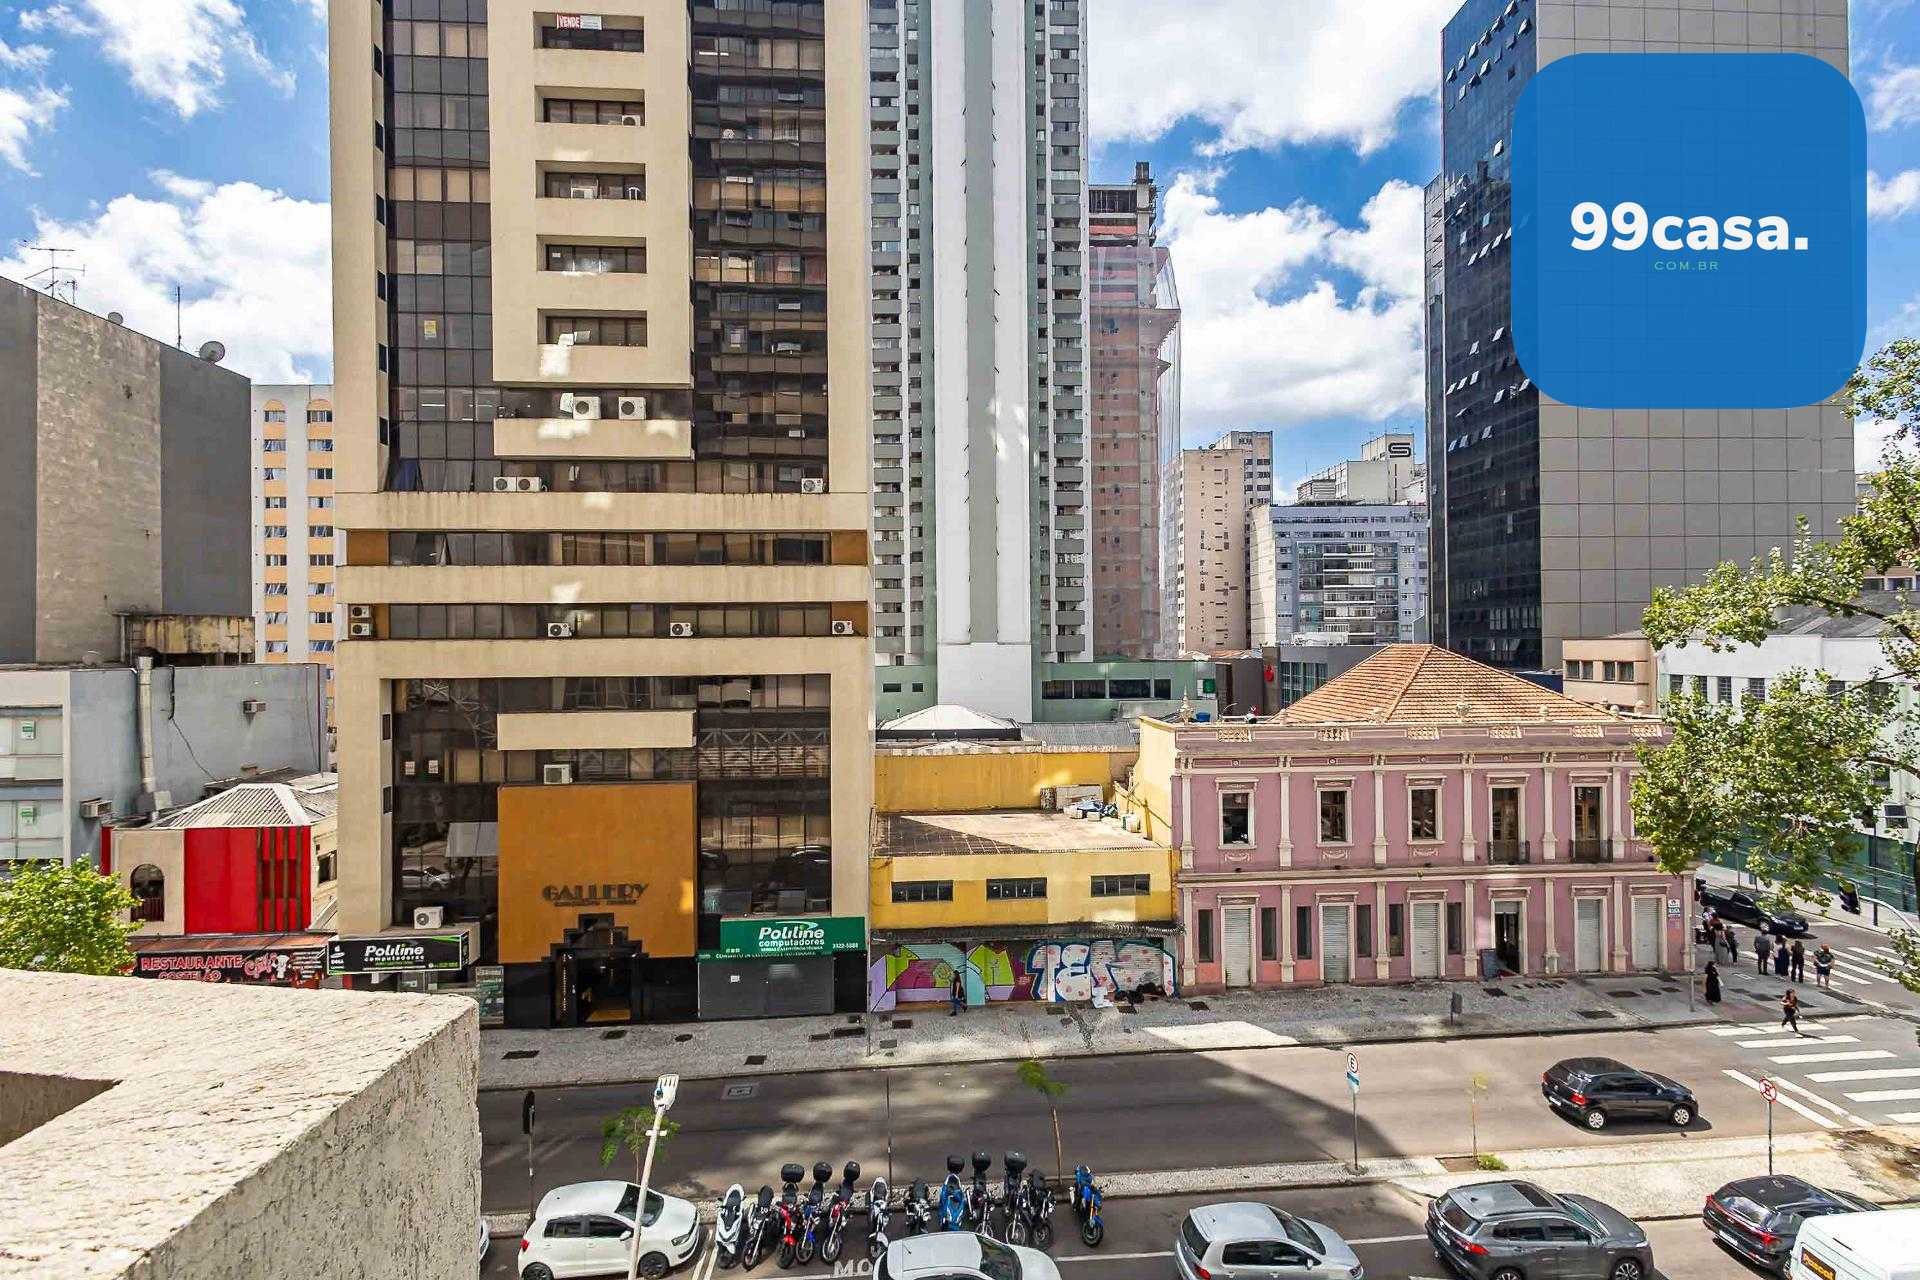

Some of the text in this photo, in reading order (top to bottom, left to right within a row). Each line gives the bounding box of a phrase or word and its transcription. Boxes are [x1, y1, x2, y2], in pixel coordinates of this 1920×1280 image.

[543, 883, 649, 901] GALLERY
[364, 943, 424, 957] Poliline
[758, 939, 825, 948] computadores
[141, 955, 243, 970] RESTAURANTE
